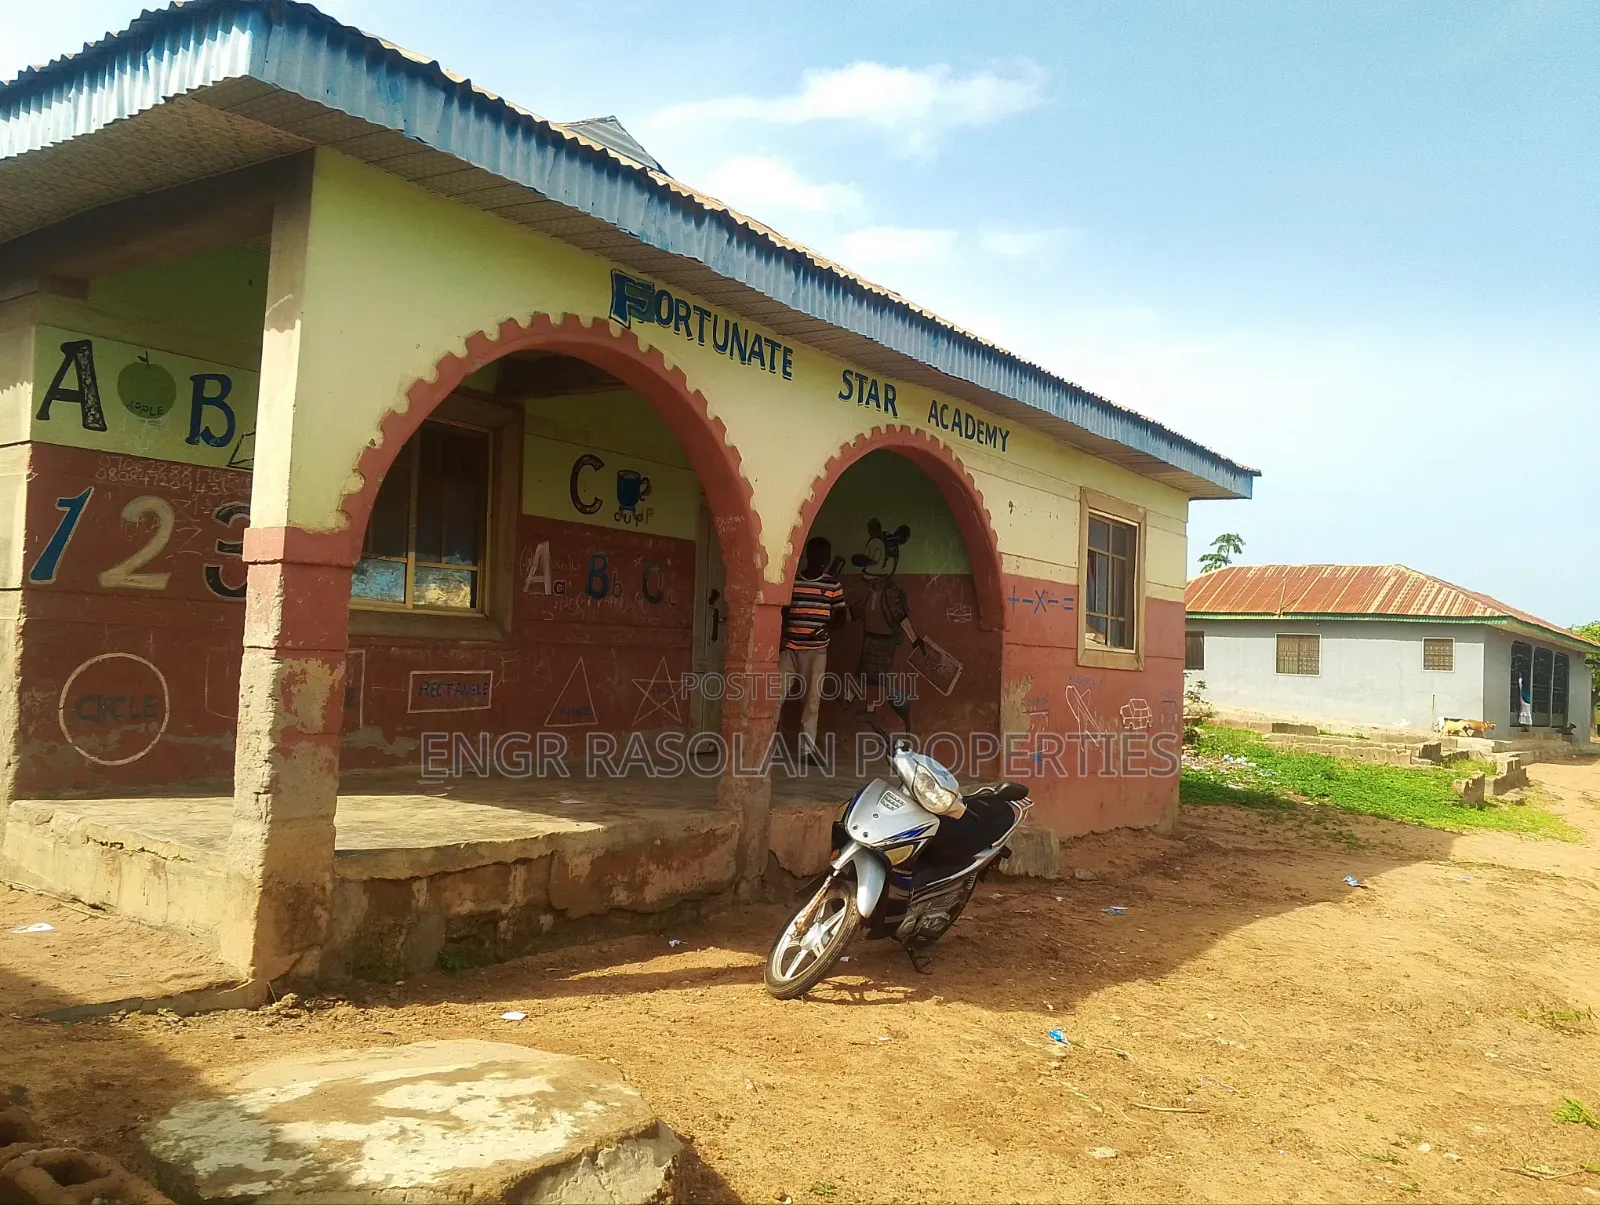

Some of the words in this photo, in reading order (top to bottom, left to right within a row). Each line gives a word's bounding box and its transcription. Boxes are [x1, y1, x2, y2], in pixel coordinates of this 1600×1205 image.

[36, 339, 107, 432] A
[609, 268, 794, 381] FORTUNATE
[838, 369, 898, 418] STAR
[927, 400, 1010, 452] ACADEMY
[125, 400, 165, 417] APPLE
[185, 373, 236, 447] B
[569, 454, 605, 515] C
[28, 486, 95, 585] 1
[98, 495, 175, 590] 2
[418, 681, 490, 698] RECTANGLE
